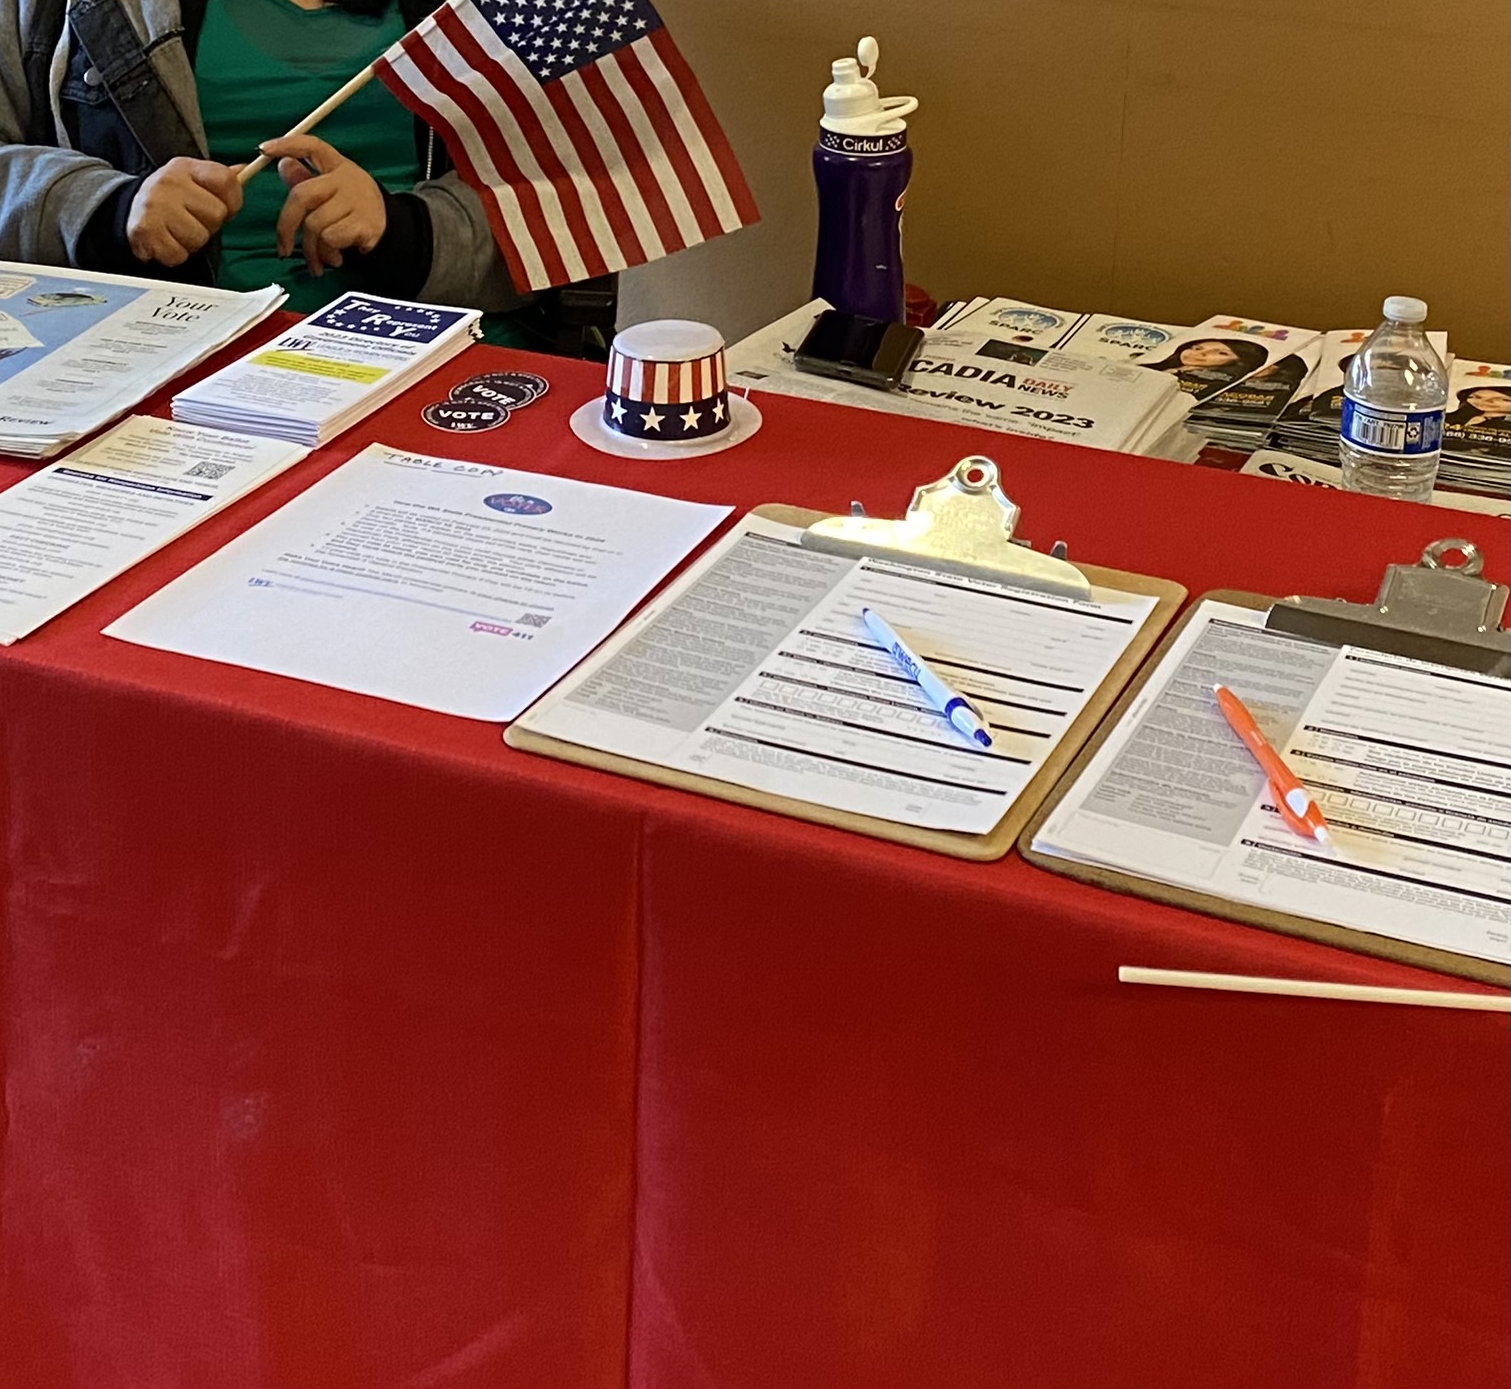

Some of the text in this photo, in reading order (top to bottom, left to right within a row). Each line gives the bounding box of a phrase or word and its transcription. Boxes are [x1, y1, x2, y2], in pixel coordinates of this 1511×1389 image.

[842, 136, 885, 152] Cirkul
[164, 295, 220, 313] Your
[342, 299, 383, 315] They
[151, 307, 201, 324] Vote
[360, 313, 439, 332] Represent
[388, 325, 422, 339] You
[988, 319, 1044, 335] SPARC
[277, 336, 315, 352] LWV
[348, 335, 402, 349] Directory
[1097, 336, 1158, 352] SPARC
[908, 359, 1018, 389] CADIA
[1017, 385, 1071, 400] NEWS
[1021, 377, 1077, 393] DAILY
[472, 384, 518, 406] VOTE
[438, 409, 495, 421] VOTE
[1010, 405, 1096, 429] 2023
[383, 451, 504, 478] TABLE COPY
[868, 557, 1104, 611] Washington State Voter Registration Form
[474, 622, 535, 641] VOTE 411
